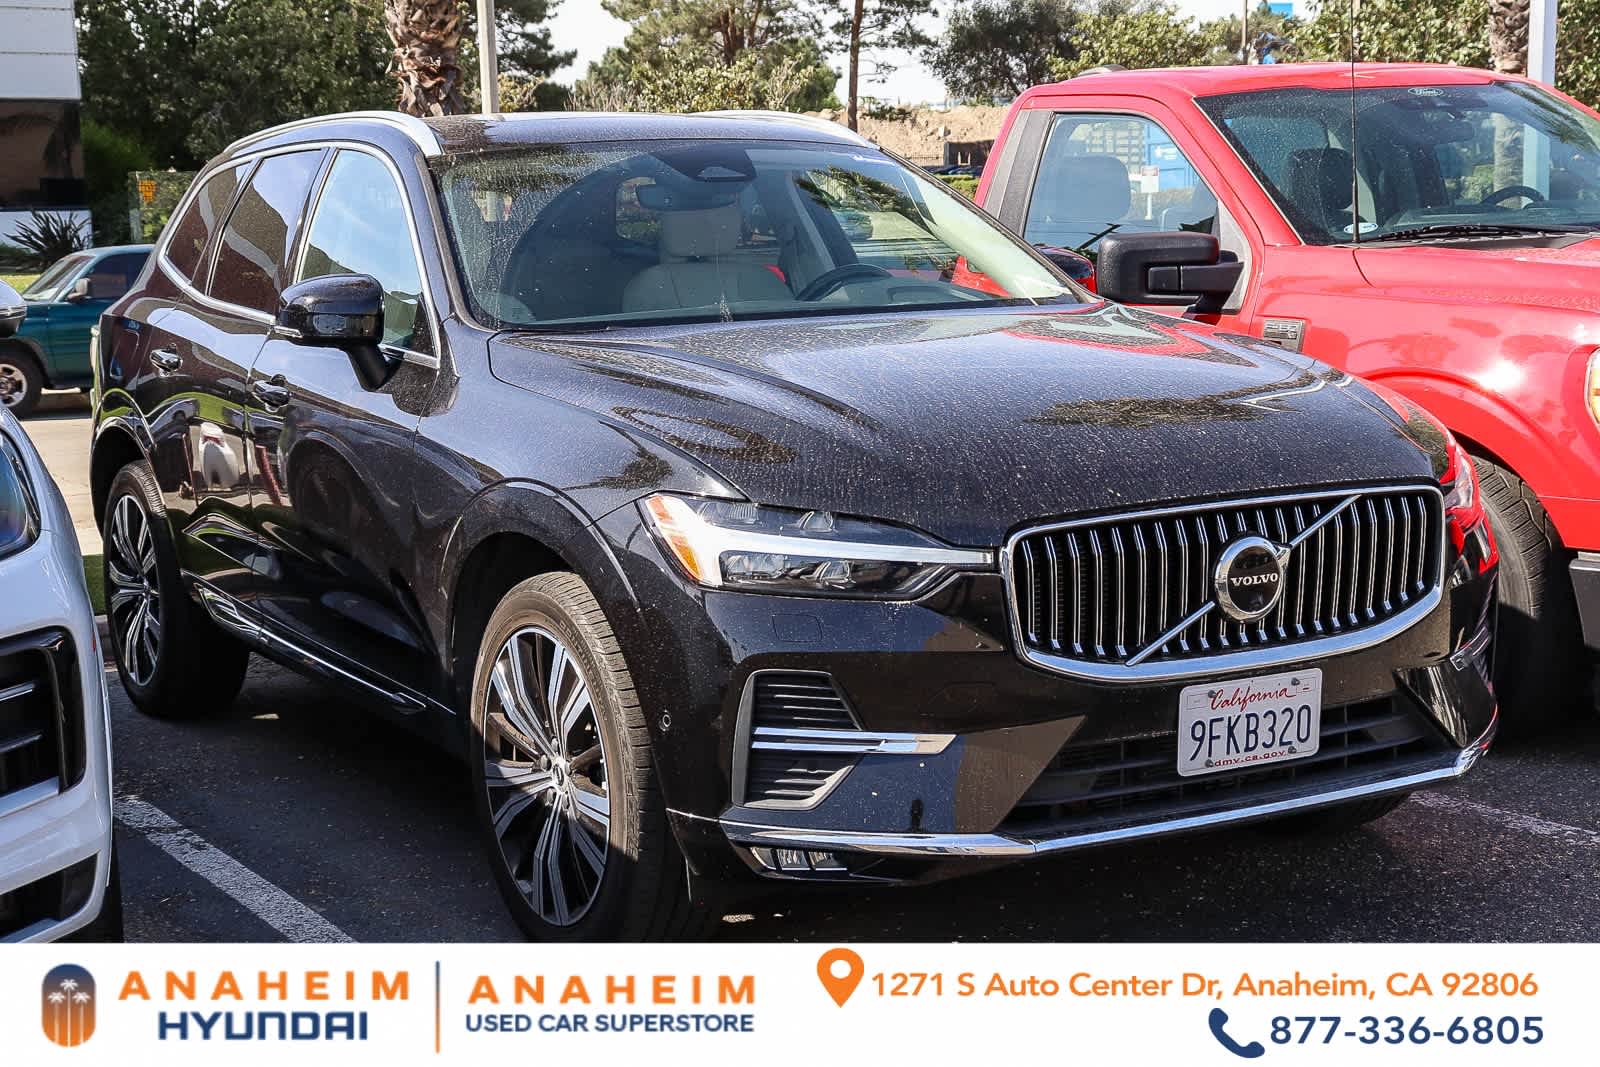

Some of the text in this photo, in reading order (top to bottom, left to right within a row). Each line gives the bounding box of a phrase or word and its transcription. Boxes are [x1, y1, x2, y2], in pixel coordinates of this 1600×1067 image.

[1230, 573, 1278, 587] VOLVO
[1210, 687, 1297, 712] California
[1190, 704, 1312, 762] 9FKB320
[1214, 749, 1287, 767] dmv.ca.gov
